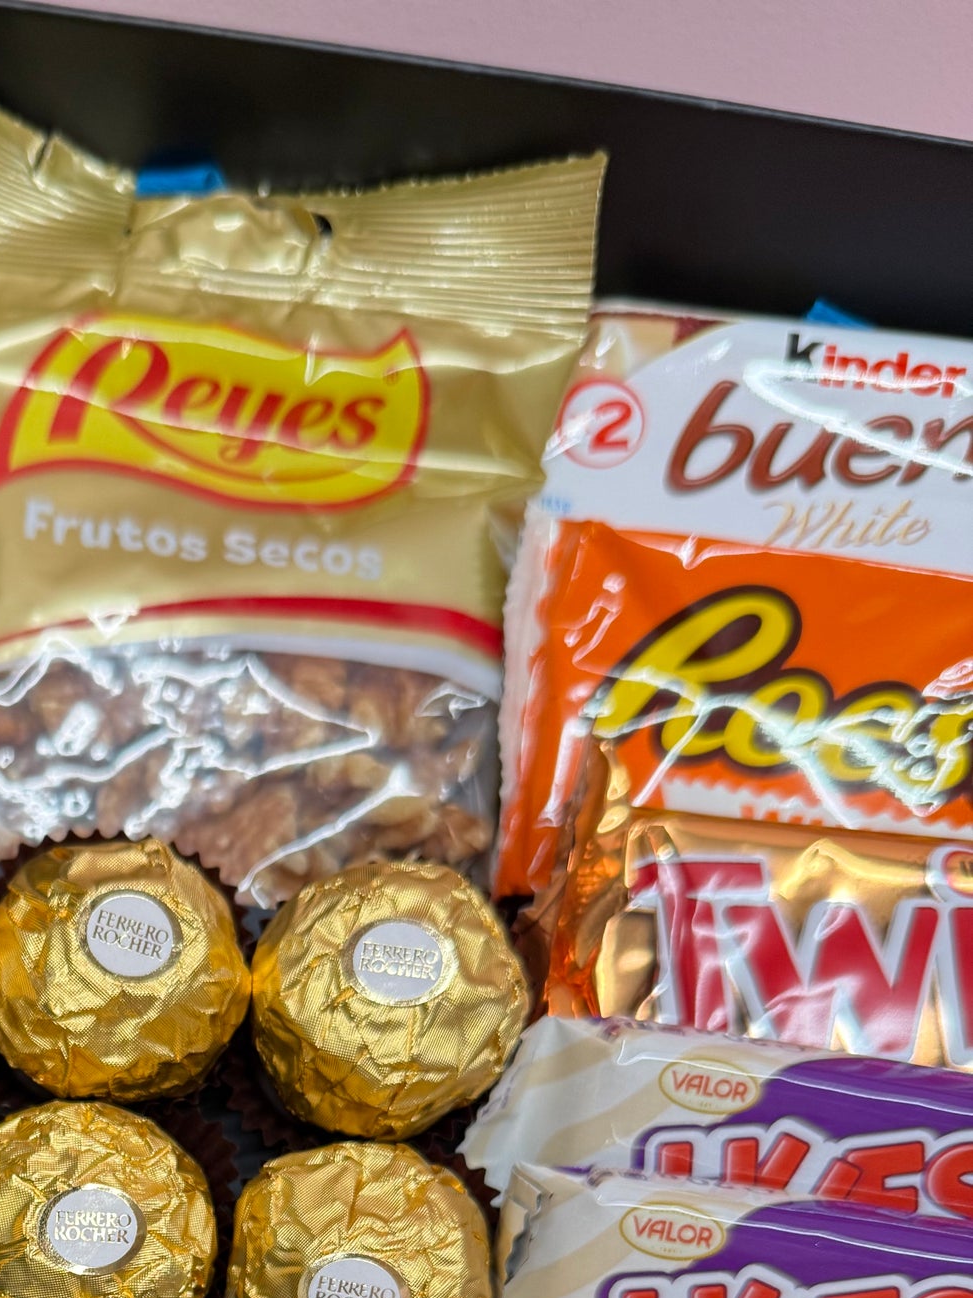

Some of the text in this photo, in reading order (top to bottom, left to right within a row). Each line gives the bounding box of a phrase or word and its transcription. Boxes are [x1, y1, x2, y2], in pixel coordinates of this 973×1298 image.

[49, 336, 387, 470] Reyes
[589, 399, 633, 453] 2
[24, 499, 384, 581] Frutos Secos
[764, 499, 930, 548] White
[92, 925, 162, 960] ROCHER
[97, 909, 169, 945] FERRERO
[359, 958, 435, 980] ROCHER
[361, 942, 438, 965] FERRERO
[672, 1070, 748, 1103] VALOR
[54, 1226, 129, 1244] ROCHER
[55, 1210, 132, 1229] FERRERO
[633, 1215, 713, 1250] VALOR
